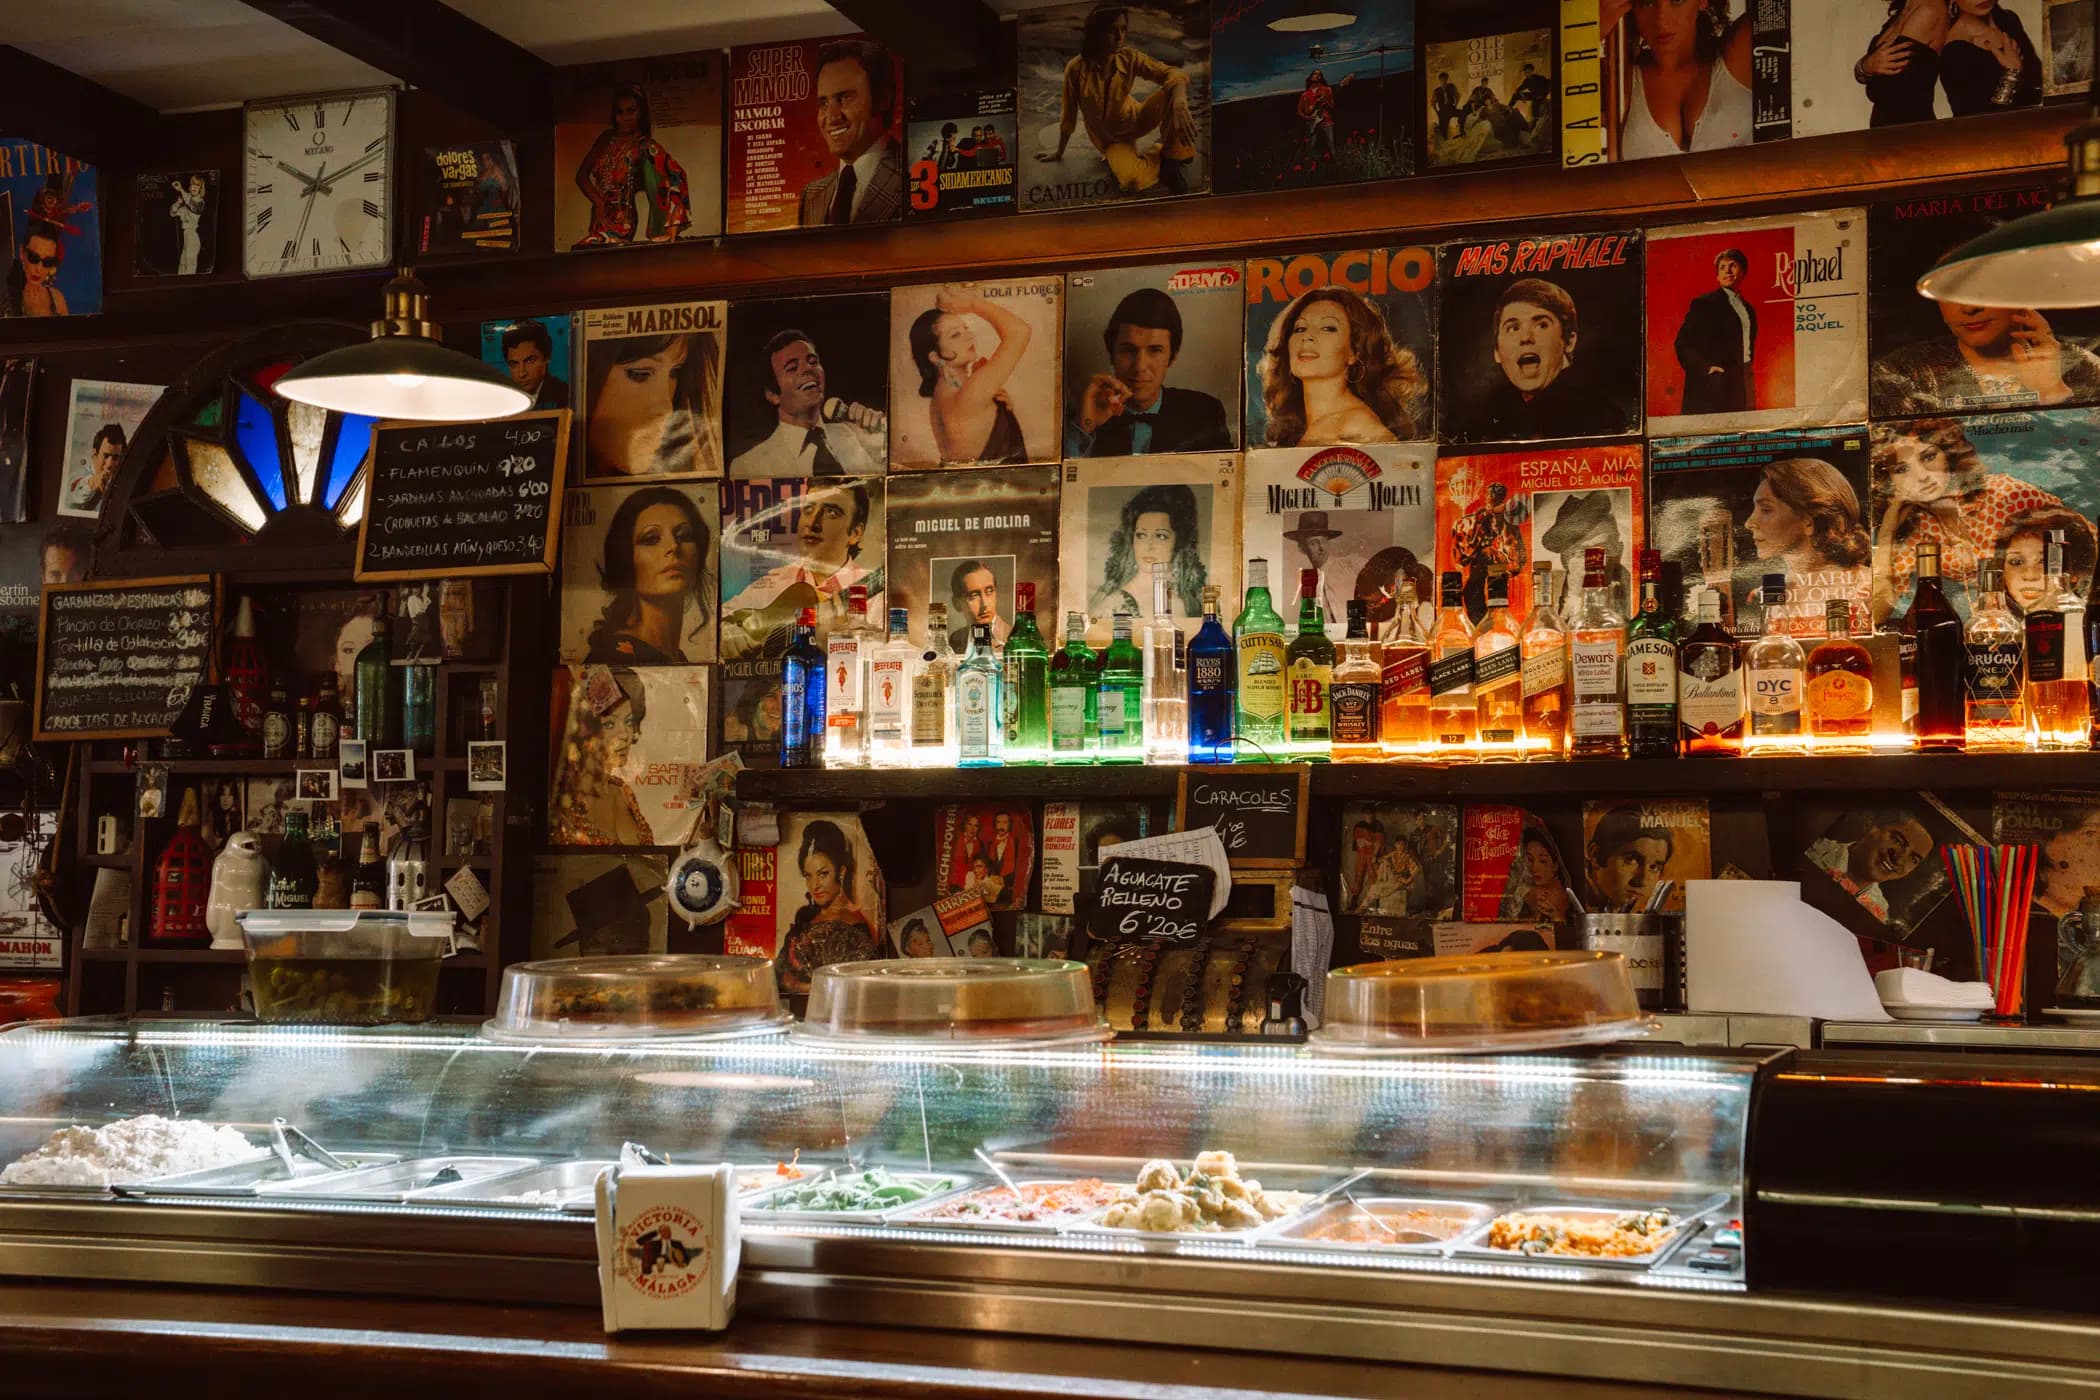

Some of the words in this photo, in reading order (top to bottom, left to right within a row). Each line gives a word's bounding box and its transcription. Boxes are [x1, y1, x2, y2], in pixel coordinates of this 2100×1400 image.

[748, 45, 805, 77] SUPER
[734, 71, 810, 106] MANOLO
[734, 105, 782, 121] MANOLO
[734, 117, 785, 133] ESCOBAR
[436, 149, 476, 168] dolores
[441, 161, 478, 181] vargas
[910, 160, 940, 211] 3
[939, 167, 1013, 191] SUDAMERICANOS
[1029, 178, 1109, 204] CAMILO
[1972, 193, 2008, 211] DEL
[1454, 245, 1510, 278] MAS
[1511, 235, 1628, 274] RAPHAEL
[1246, 247, 1436, 304] ROCIO
[1771, 246, 1843, 297] Raphael
[983, 285, 1012, 298] LOLA
[1017, 283, 1062, 297] FLORES
[1797, 304, 1817, 312] YO
[627, 305, 722, 335] MARISOL
[1796, 312, 1826, 322] SOY
[1796, 321, 1844, 332] AQUEL
[1520, 456, 1592, 477] ESPAÑA
[1602, 456, 1638, 472] MIA
[1521, 477, 1563, 489] MIGUEL
[1569, 475, 1585, 486] DE
[1590, 473, 1638, 485] MOLINA
[1266, 484, 1319, 514] MIGUEL
[1368, 481, 1421, 512] MOLINA
[915, 518, 961, 534] MIGUEL
[964, 517, 980, 531] DE
[983, 514, 1031, 530] MOLINA
[751, 528, 771, 543] PERET
[829, 642, 858, 654] BEEFEATER
[1240, 634, 1268, 650] CUTTY
[1574, 650, 1615, 665] Dewar's
[1627, 643, 1674, 660] JAMESON
[1968, 653, 2019, 665] BRUGAL
[724, 660, 753, 680] MIGUEL
[874, 661, 903, 673] BEEFEATER
[1195, 657, 1222, 667] RIVES
[1452, 661, 1473, 675] LABEL
[1196, 666, 1222, 678] 1880
[1384, 674, 1400, 685] RED
[1401, 664, 1425, 680] LABEL
[1332, 687, 1348, 701] JACK
[1347, 686, 1372, 700] DANIEL'S
[1684, 682, 1737, 700] Ballantine's
[1757, 679, 1792, 694] DYC
[1290, 678, 1324, 714] J&B
[1769, 696, 1779, 705] 8
[1448, 735, 1457, 743] 12
[1194, 784, 1292, 805] CARACOLES
[1045, 817, 1075, 830] FLORES
[1640, 816, 1702, 828] MANUEL
[1104, 862, 1199, 893] AGUACATE
[1100, 886, 1182, 910] RELLENO
[1360, 922, 1393, 937] Entre
[1360, 934, 1381, 947] dos
[1384, 937, 1419, 951] aguas
[629, 1211, 699, 1237] VICTORIA
